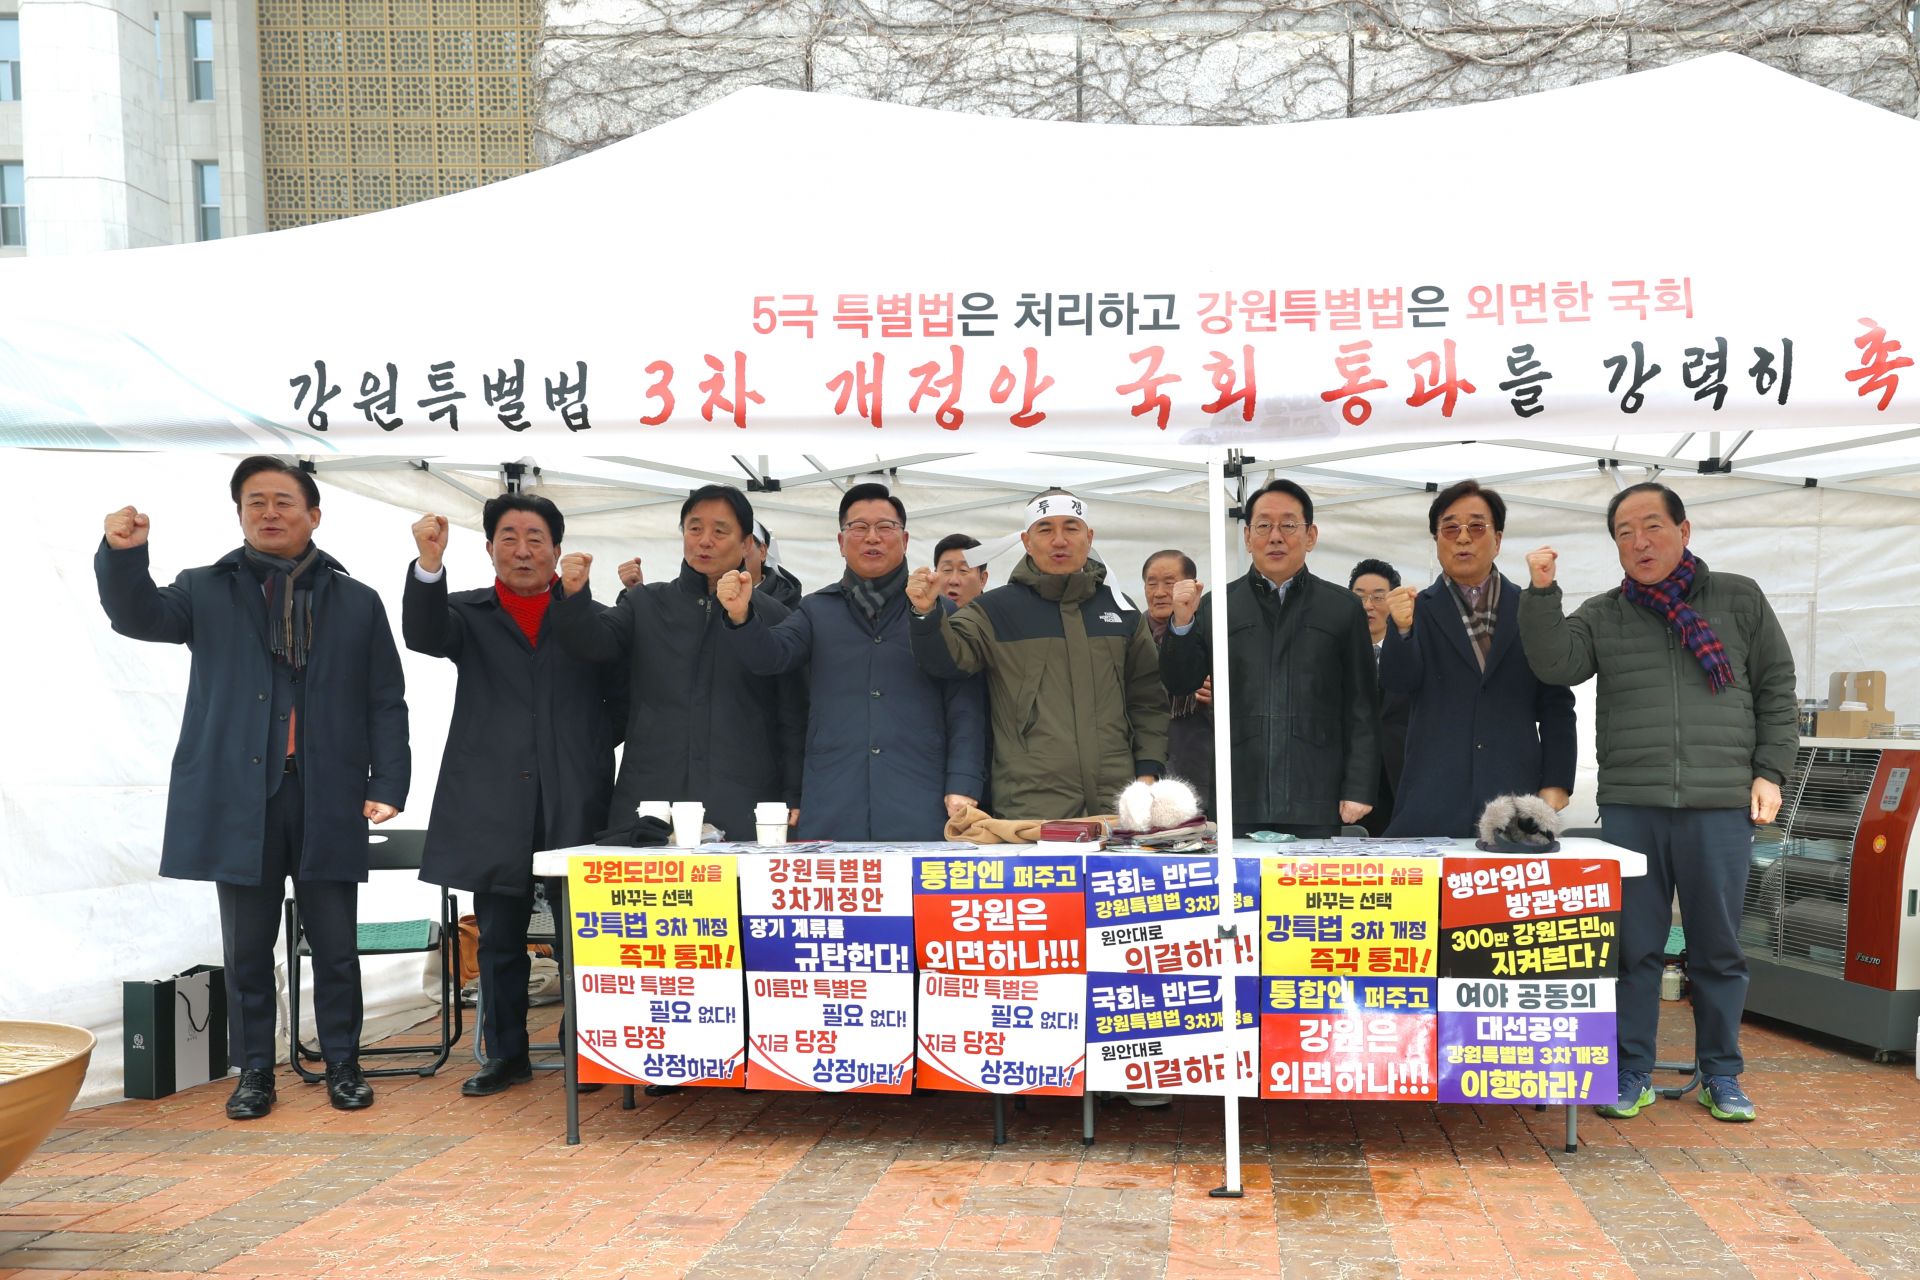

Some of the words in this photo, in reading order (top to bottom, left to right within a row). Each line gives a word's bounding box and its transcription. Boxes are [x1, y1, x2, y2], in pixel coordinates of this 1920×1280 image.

[752, 293, 819, 338] 5극
[832, 291, 999, 338] 특별법은
[1014, 290, 1181, 337] 처리하고
[1196, 285, 1449, 332] 강원특별법은
[1466, 281, 1594, 326] 외면한
[1606, 277, 1695, 320] 국회
[289, 359, 592, 434] 강원특별법
[639, 350, 766, 430] 3차
[825, 346, 1056, 431] 개정안
[1115, 340, 1256, 431] 국회
[1320, 338, 1553, 426] 통과를
[1602, 336, 1794, 413] 강력히
[1844, 316, 1915, 412] 촉
[582, 861, 685, 884] 강원도민의
[691, 864, 723, 883] 삶을
[769, 858, 882, 883] 강원특별법
[920, 860, 1004, 889] 통합엔
[1013, 865, 1077, 889] 퍼주고
[1091, 870, 1156, 896] 국회는
[1277, 863, 1384, 887] 강원도민의
[1390, 867, 1424, 886] 삶을
[1447, 860, 1551, 899] 행안위의
[611, 890, 658, 907] 바꾸는
[662, 889, 693, 907] 선택
[771, 886, 884, 913] 3차개정안
[1095, 892, 1181, 919] 강원특별법
[1306, 892, 1355, 909] 바꾸는
[1360, 892, 1393, 909] 선택
[1505, 883, 1610, 919] 방관행태
[575, 912, 648, 939] 강특법
[655, 917, 687, 937] 3차
[693, 917, 728, 937] 개정
[749, 919, 785, 938] 장기
[791, 918, 845, 939] 계류를
[950, 899, 1048, 932] 강원은
[1266, 915, 1342, 942] 강특법
[1351, 922, 1384, 940] 3차
[1393, 921, 1427, 940] 개정
[1101, 925, 1164, 945] 원안대로
[1451, 928, 1509, 951] 300만
[1512, 916, 1615, 946] 강원도민이
[620, 943, 667, 969] 즉각
[674, 944, 735, 969] 통과!
[795, 942, 910, 972] 규탄한다!
[925, 939, 1080, 972] 외면하나!!!
[1310, 948, 1360, 972] 즉각
[1368, 947, 1432, 973] 통과!
[1491, 942, 1610, 977] 지켜본다!
[582, 974, 635, 994] 이름만
[641, 976, 695, 996] 특별은
[754, 978, 808, 998] 이름만
[813, 979, 868, 1000] 특별은
[926, 977, 979, 998] 이름만
[984, 979, 1039, 1000] 특별은
[1092, 985, 1155, 1011] 국회는
[1268, 980, 1354, 1009] 통합엔
[1364, 987, 1429, 1009] 퍼주고
[1456, 983, 1508, 1008] 여야
[1518, 983, 1596, 1009] 공동의
[649, 1000, 692, 1024] 필요
[698, 1006, 736, 1024] 없다!
[822, 1003, 864, 1027] 필요
[870, 1010, 907, 1028] 없다!
[991, 1004, 1034, 1028] 필요
[1041, 1011, 1078, 1029] 없다!
[1095, 1009, 1180, 1034] 강원특별법
[585, 1028, 617, 1048] 지금
[623, 1026, 666, 1050] 당장
[757, 1033, 789, 1053] 지금
[795, 1030, 838, 1054] 당장
[1299, 1019, 1399, 1053] 강원은
[1476, 1017, 1578, 1042] 대선공약
[925, 1034, 956, 1052] 지금
[963, 1031, 1006, 1055] 당장
[1101, 1042, 1164, 1061] 원안대로
[1446, 1046, 1533, 1064] 강원특별법
[1539, 1045, 1609, 1065] 3차개정
[643, 1053, 736, 1079] 상정하라!
[813, 1058, 904, 1085] 상정하라!
[980, 1060, 1075, 1086] 상정하라!
[1270, 1061, 1429, 1095] 외면하나!!!
[1460, 1070, 1592, 1100] 이행하라!
